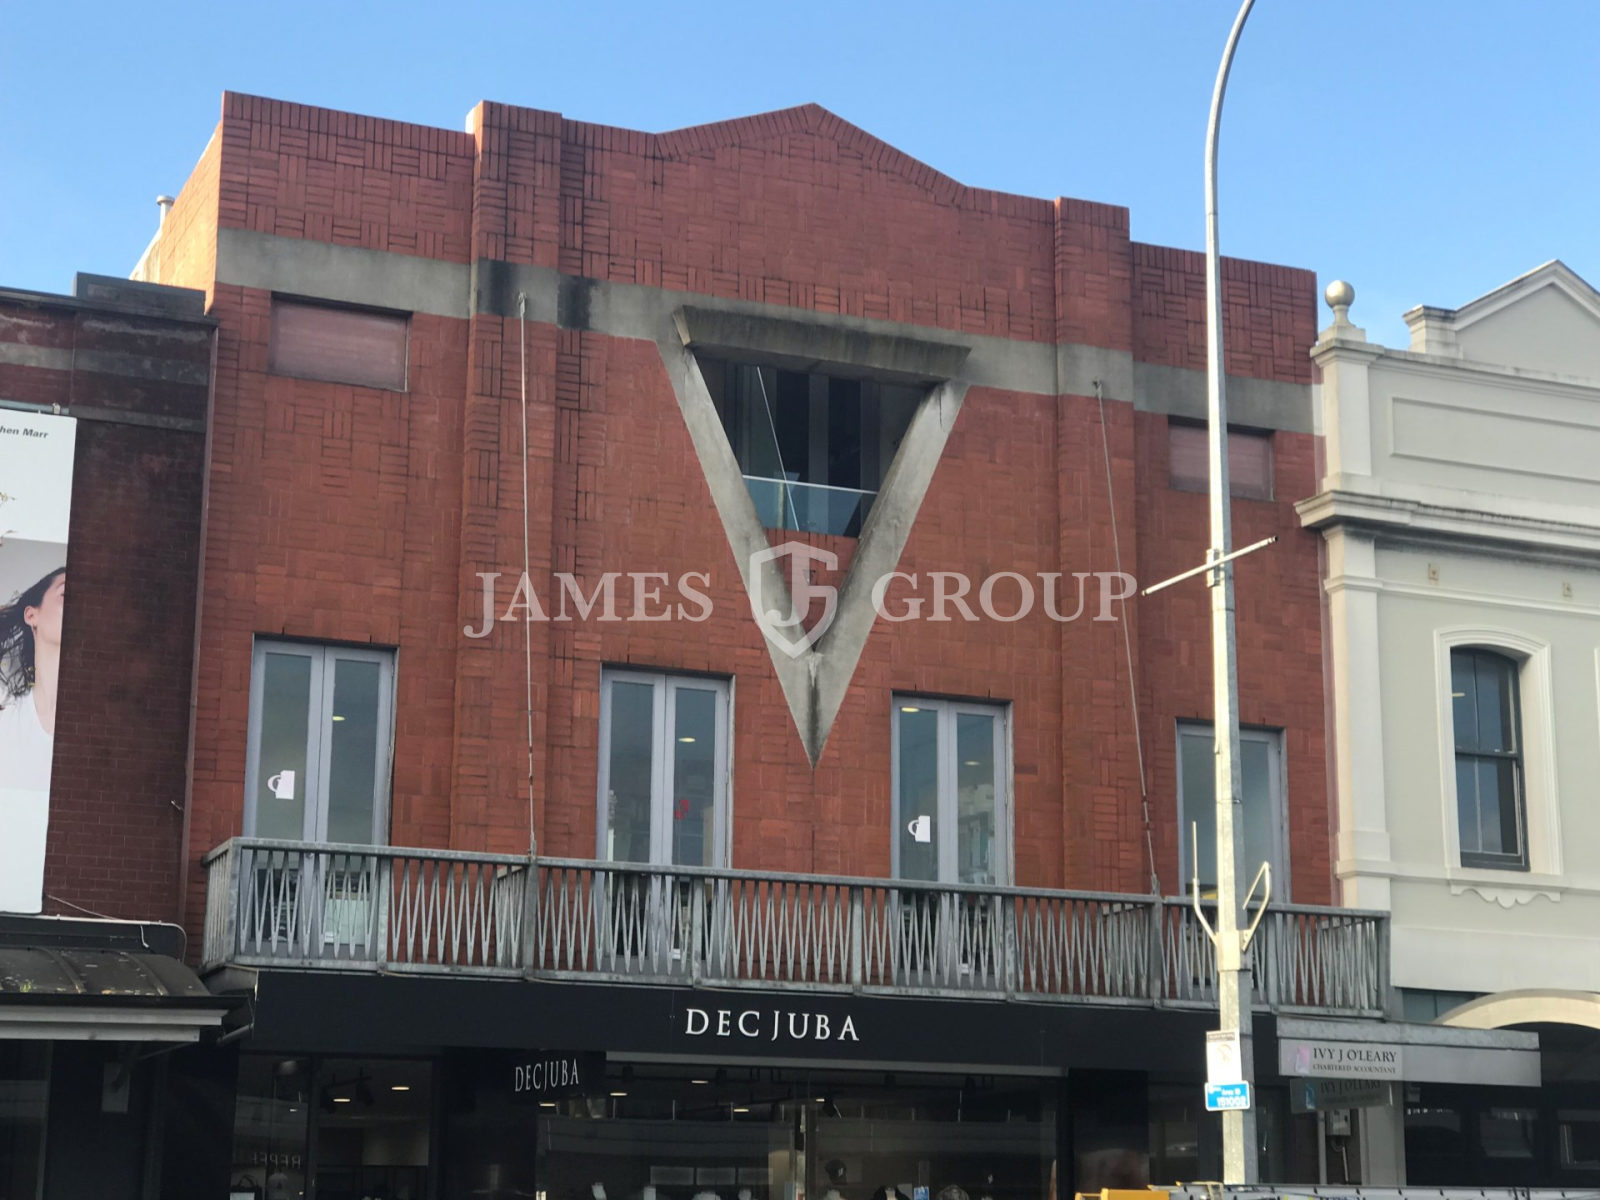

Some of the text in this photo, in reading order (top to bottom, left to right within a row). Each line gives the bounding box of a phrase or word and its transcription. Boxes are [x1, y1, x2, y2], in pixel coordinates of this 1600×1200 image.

[22, 428, 48, 438] Marr
[685, 1008, 860, 1041] DECJUBA
[1313, 1047, 1397, 1063] IVY J O'LEARY
[514, 1058, 579, 1092] DECJUBA
[1313, 1063, 1396, 1074] CHARTERED ACCOUNTANT
